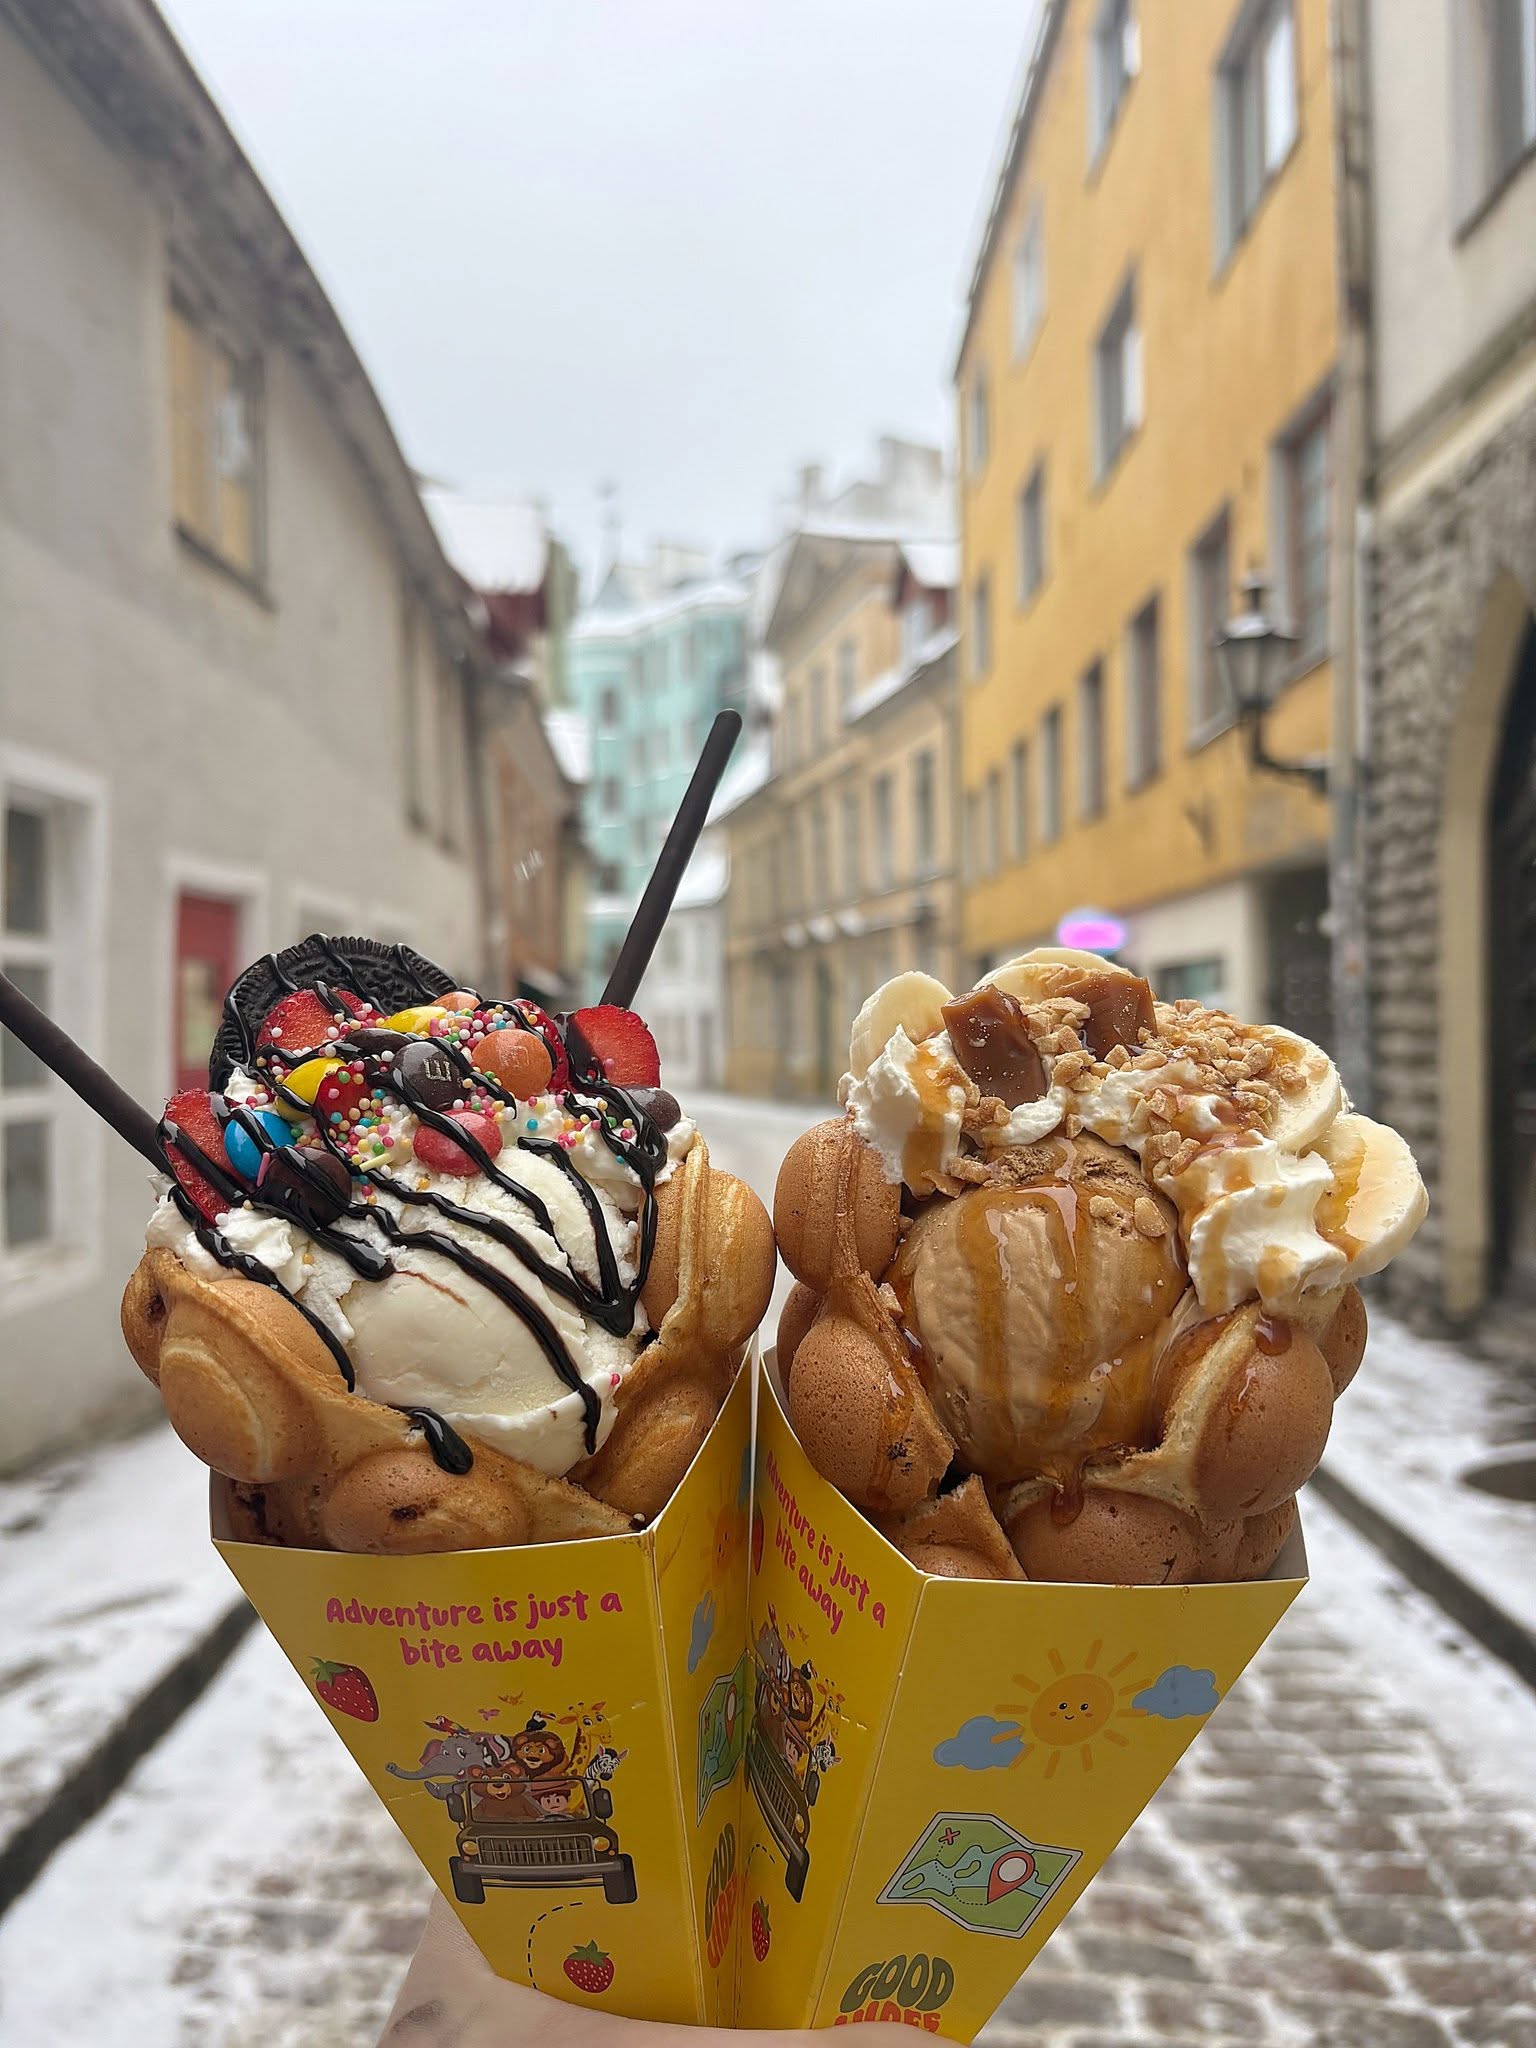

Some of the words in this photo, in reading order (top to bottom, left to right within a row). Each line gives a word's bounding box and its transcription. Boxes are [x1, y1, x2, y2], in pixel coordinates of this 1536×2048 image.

[766, 1449, 816, 1550] Adventure
[818, 1534, 833, 1566] is
[830, 1552, 870, 1612] just
[872, 1601, 886, 1629] a
[775, 1517, 797, 1571] bite
[798, 1564, 844, 1635] away
[325, 1597, 485, 1631] Adventure
[492, 1596, 518, 1623] is
[525, 1589, 589, 1630] just
[600, 1591, 623, 1613] a
[399, 1637, 463, 1669] bite
[472, 1637, 563, 1668] away
[704, 1822, 736, 1942] GOOD
[839, 1953, 955, 2014] GOOD
